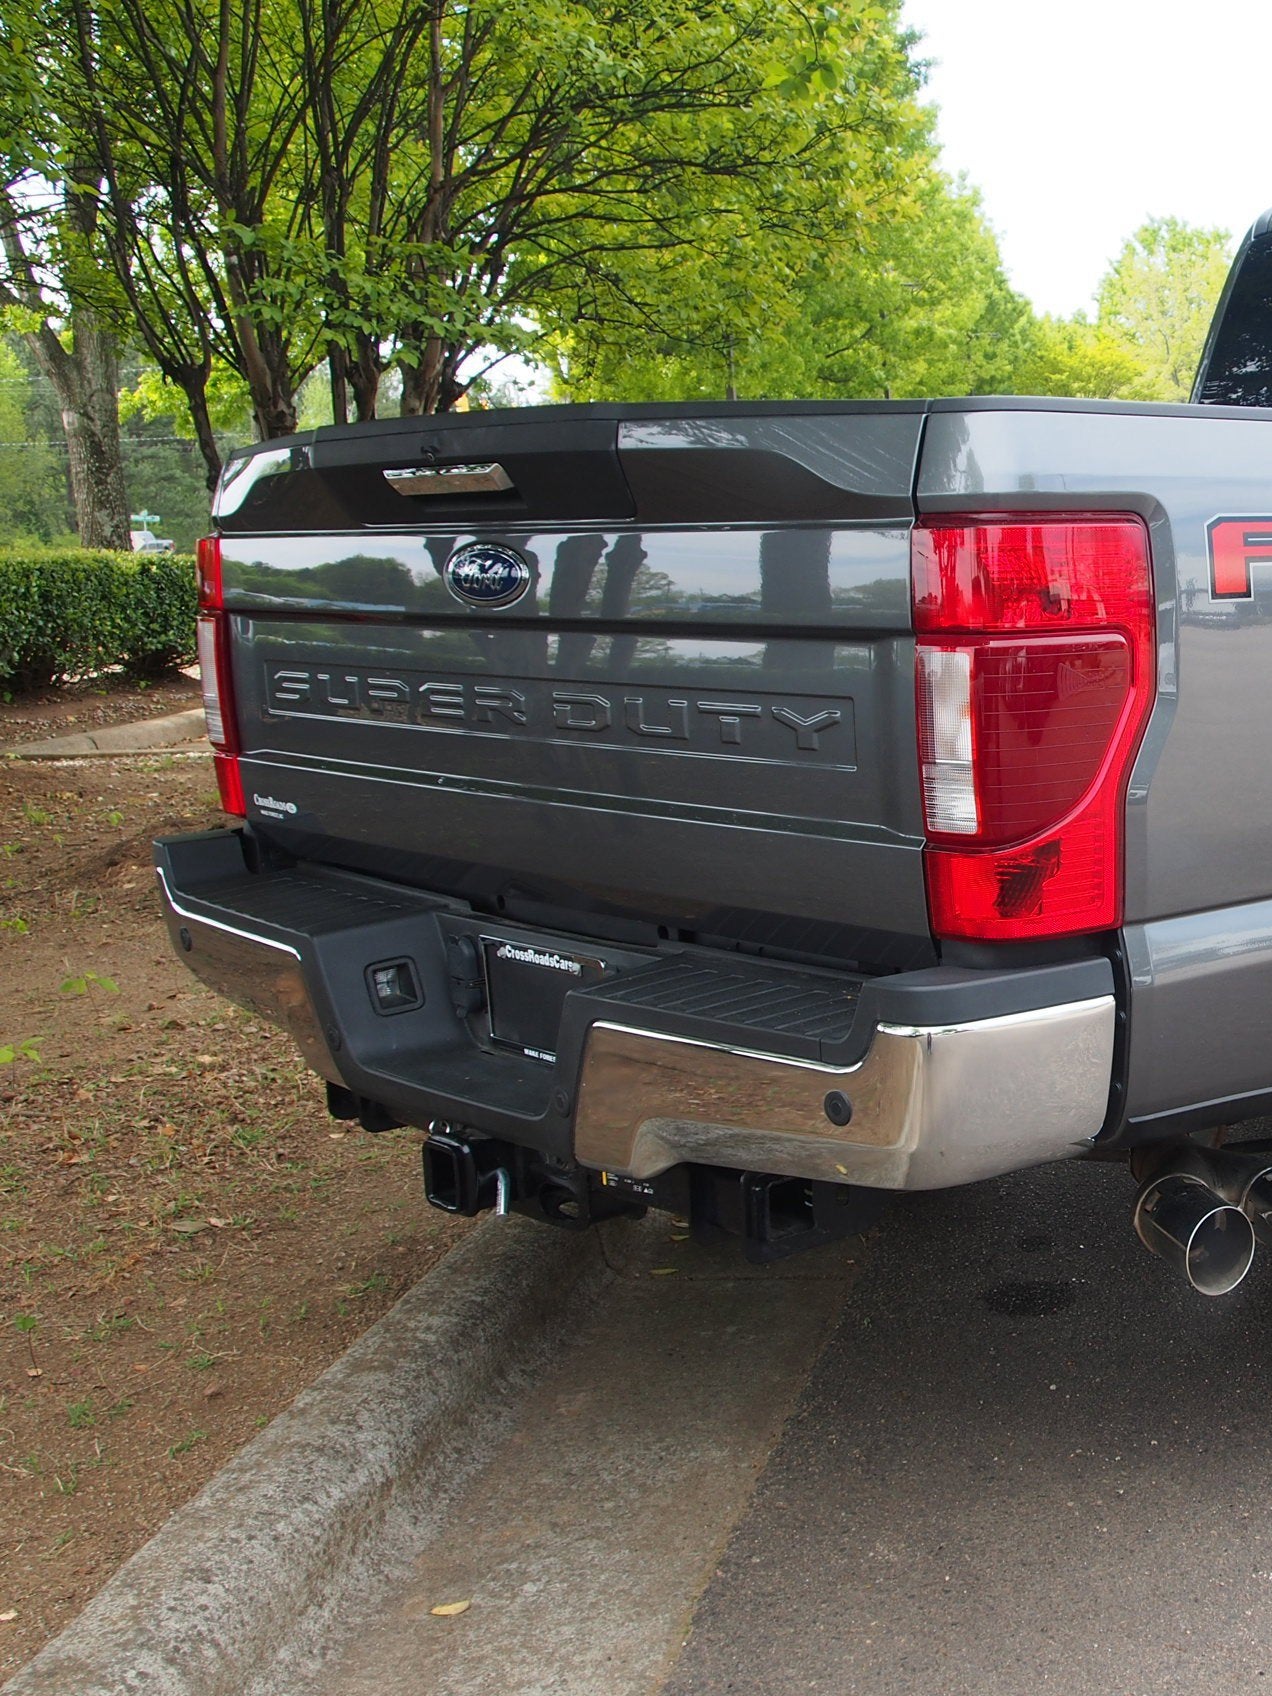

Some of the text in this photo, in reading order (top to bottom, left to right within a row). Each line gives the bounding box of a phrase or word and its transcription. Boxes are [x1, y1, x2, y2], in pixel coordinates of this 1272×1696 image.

[274, 670, 841, 751] SUPER DUTY
[539, 1051, 556, 1063] FORES
